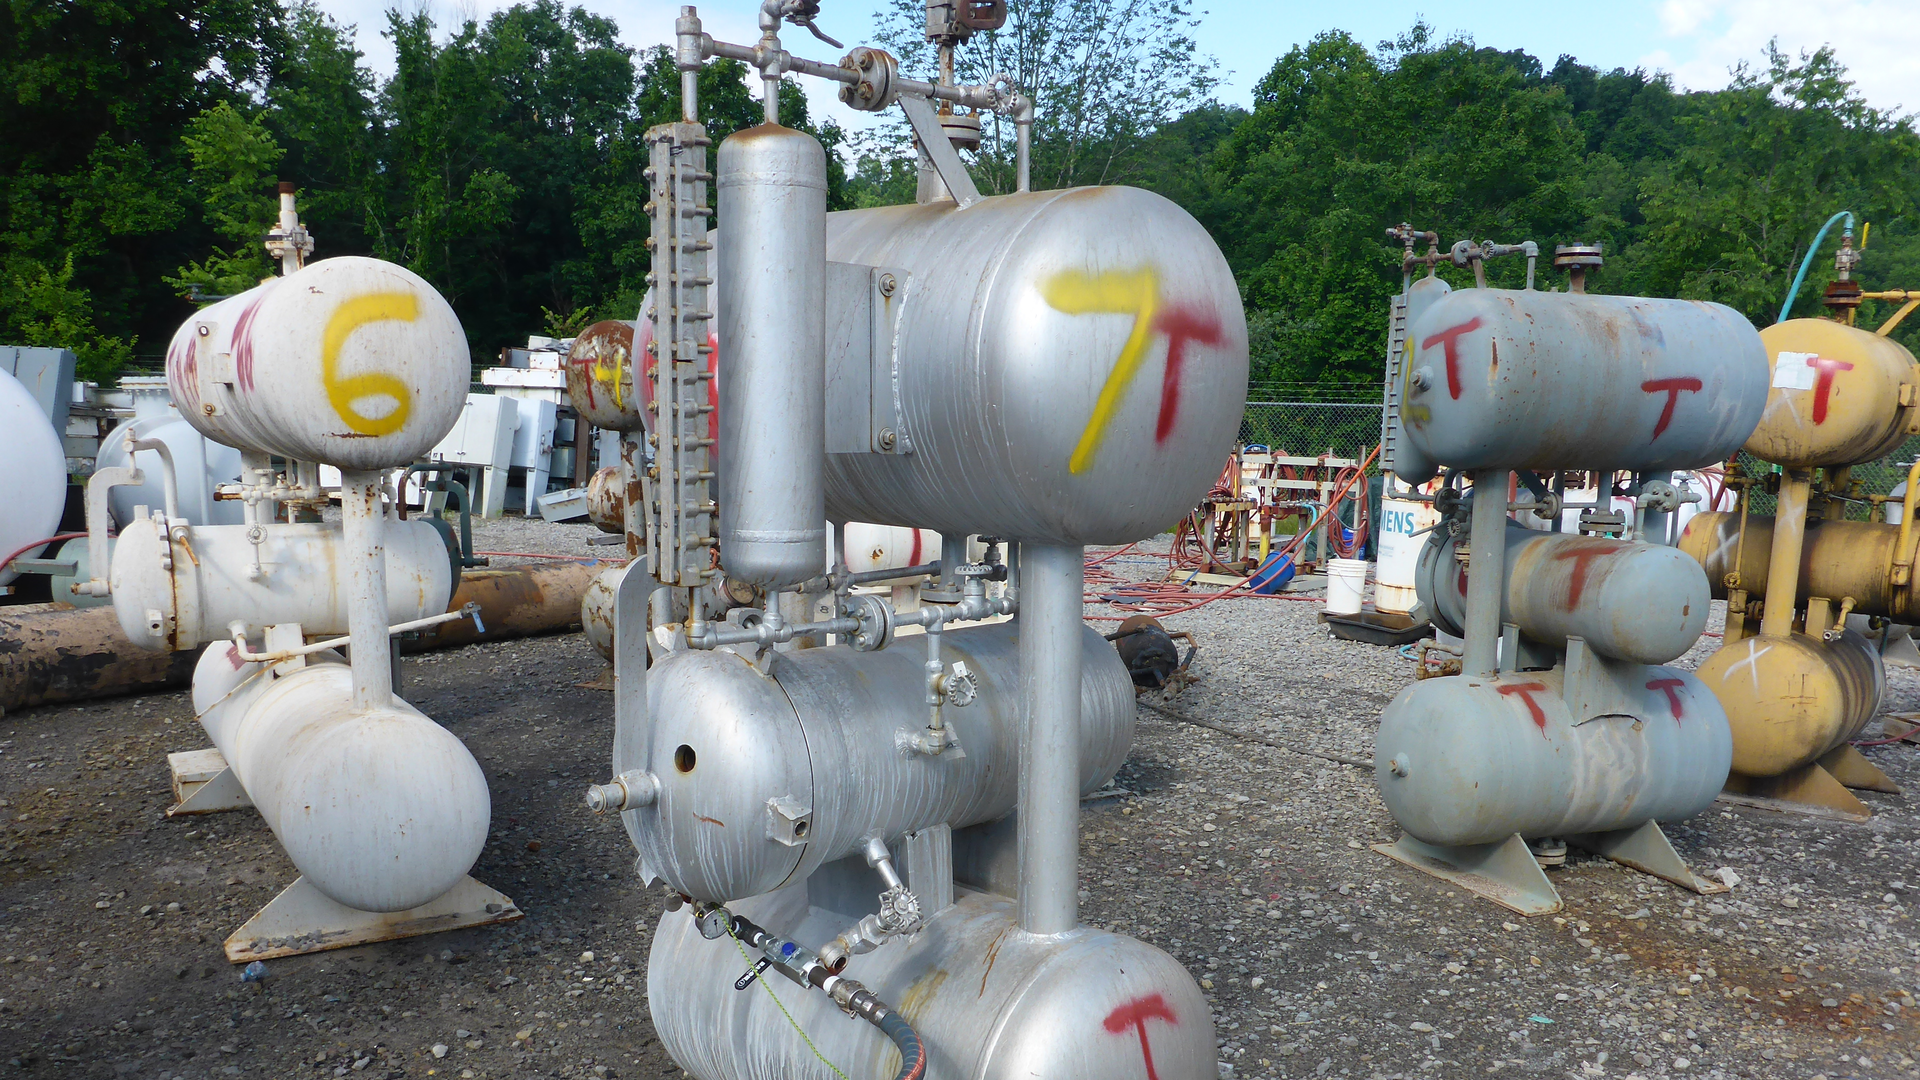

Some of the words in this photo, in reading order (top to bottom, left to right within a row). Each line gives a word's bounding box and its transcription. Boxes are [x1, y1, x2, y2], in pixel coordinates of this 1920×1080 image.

[322, 291, 419, 437] 6
[1422, 316, 1482, 400] T
[1806, 357, 1854, 426] T
[1641, 377, 1702, 444] T
[1550, 547, 1620, 614] T
[1496, 682, 1546, 740] T
[1645, 678, 1685, 728] T
[1103, 993, 1180, 1080] T
